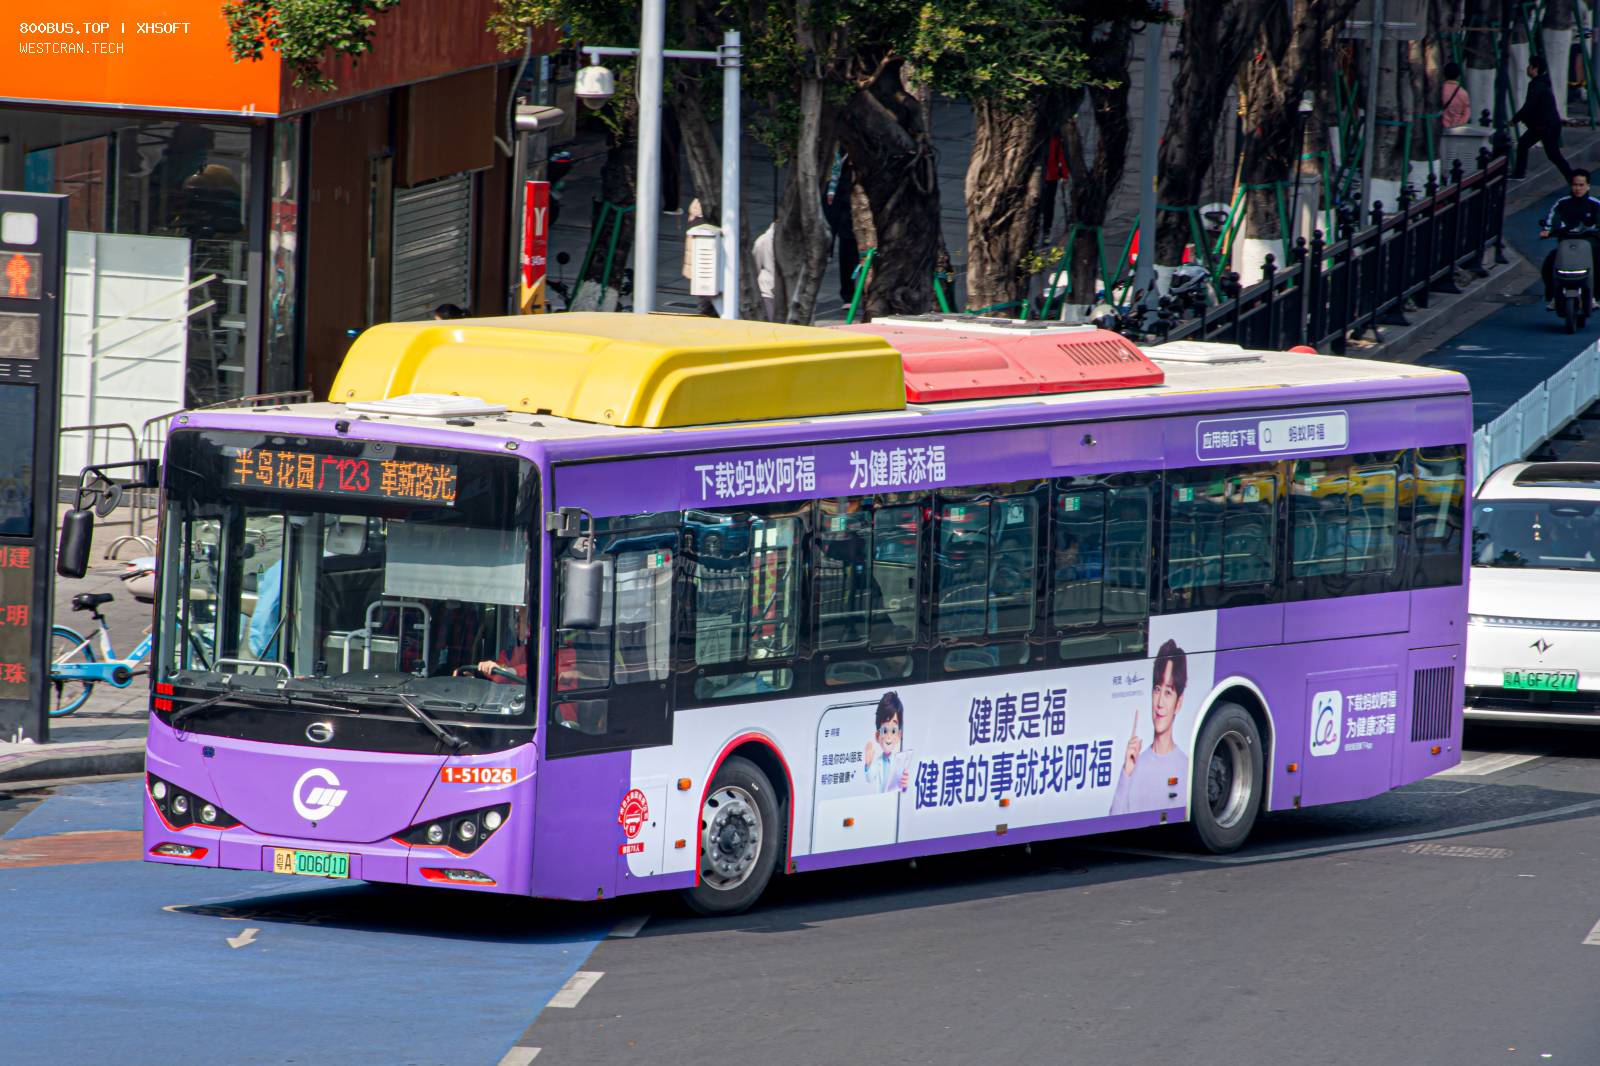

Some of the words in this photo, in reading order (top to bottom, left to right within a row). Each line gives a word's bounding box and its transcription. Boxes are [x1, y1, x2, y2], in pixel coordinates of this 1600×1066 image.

[1202, 428, 1256, 449] 应用商店下载
[1288, 423, 1325, 443] 蚂蚁阿福
[234, 448, 315, 490] 半岛花园
[318, 455, 370, 491] 广123
[380, 460, 457, 501] 革新路光
[694, 455, 816, 501] 下载蚂蚁阿福
[849, 445, 946, 489] 为健康添福
[0, 605, 29, 626] 明
[0, 663, 28, 684] 珠
[1527, 672, 1576, 689] GF7277
[1346, 690, 1397, 712] 下载蚂蚁阿福
[968, 688, 1068, 746] 健康是福
[1346, 713, 1396, 738] 为健康添福
[445, 767, 513, 783] 1-51026
[914, 740, 1114, 810] 健康的事就找阿福
